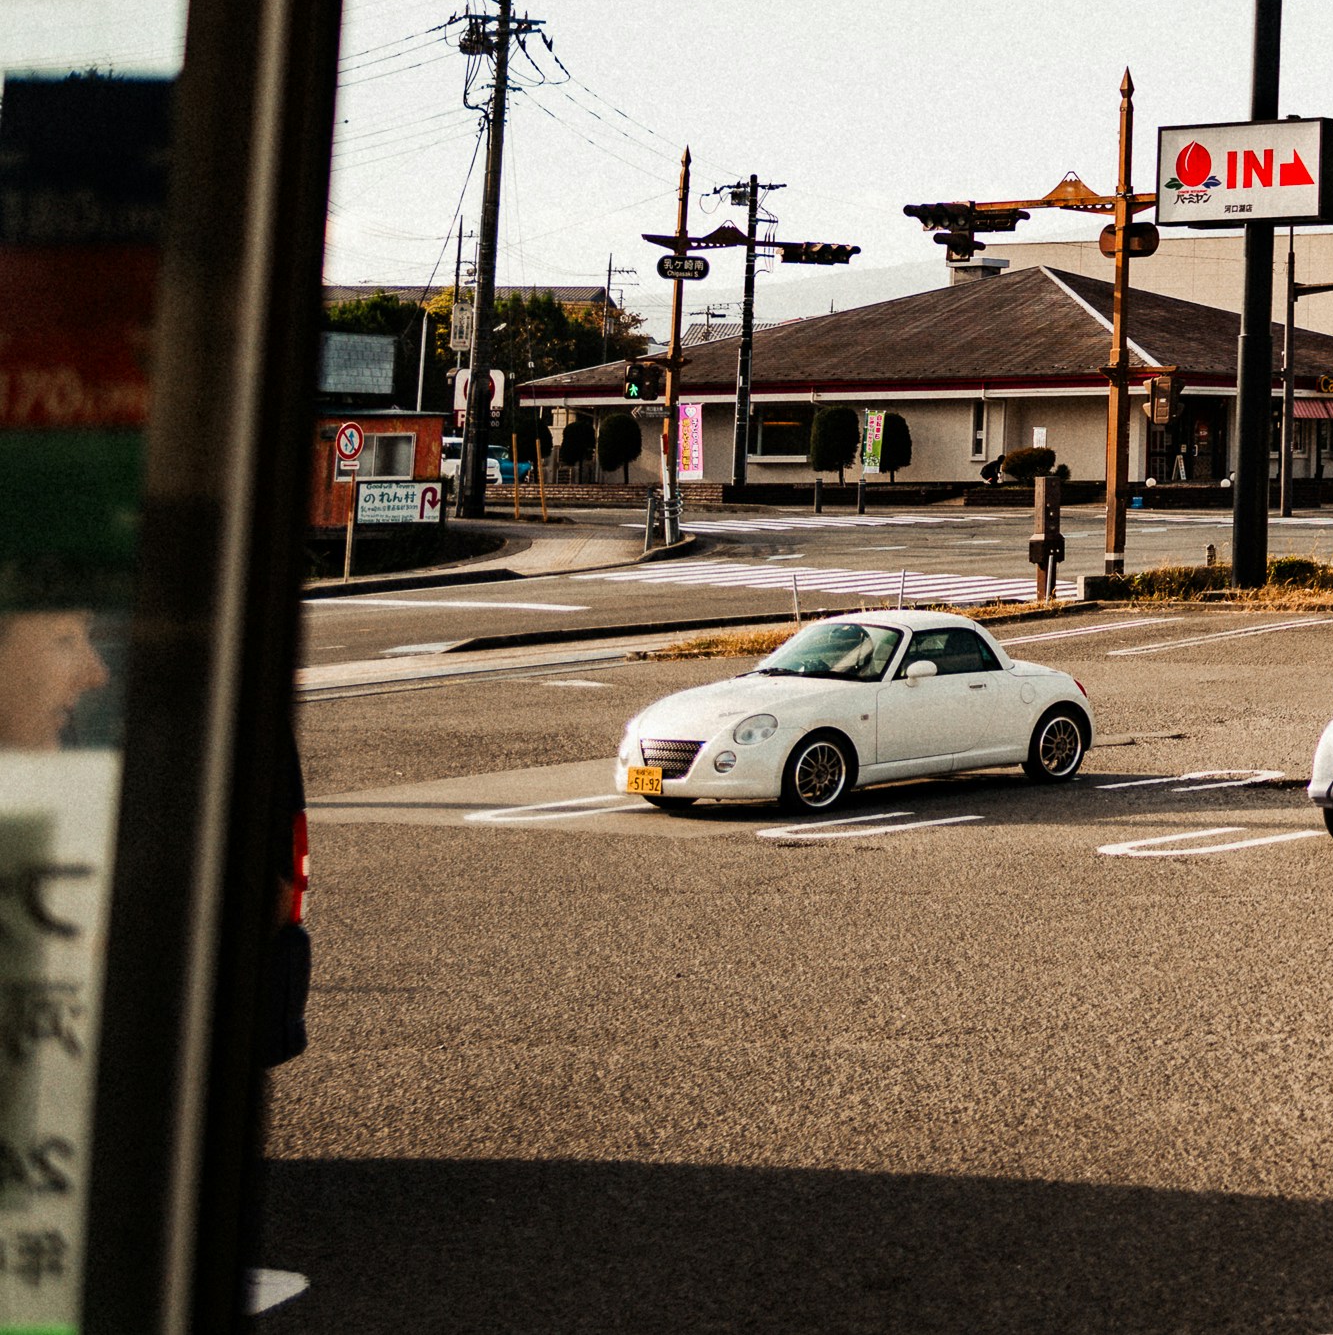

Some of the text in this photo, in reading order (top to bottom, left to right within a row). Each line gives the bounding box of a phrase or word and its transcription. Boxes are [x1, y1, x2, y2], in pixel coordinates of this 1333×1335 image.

[1226, 149, 1274, 189] IN
[1173, 193, 1212, 205] バーミヤン
[1224, 204, 1253, 214] 河口湖店
[363, 491, 417, 504] のれん村
[634, 777, 660, 791] 51-92
